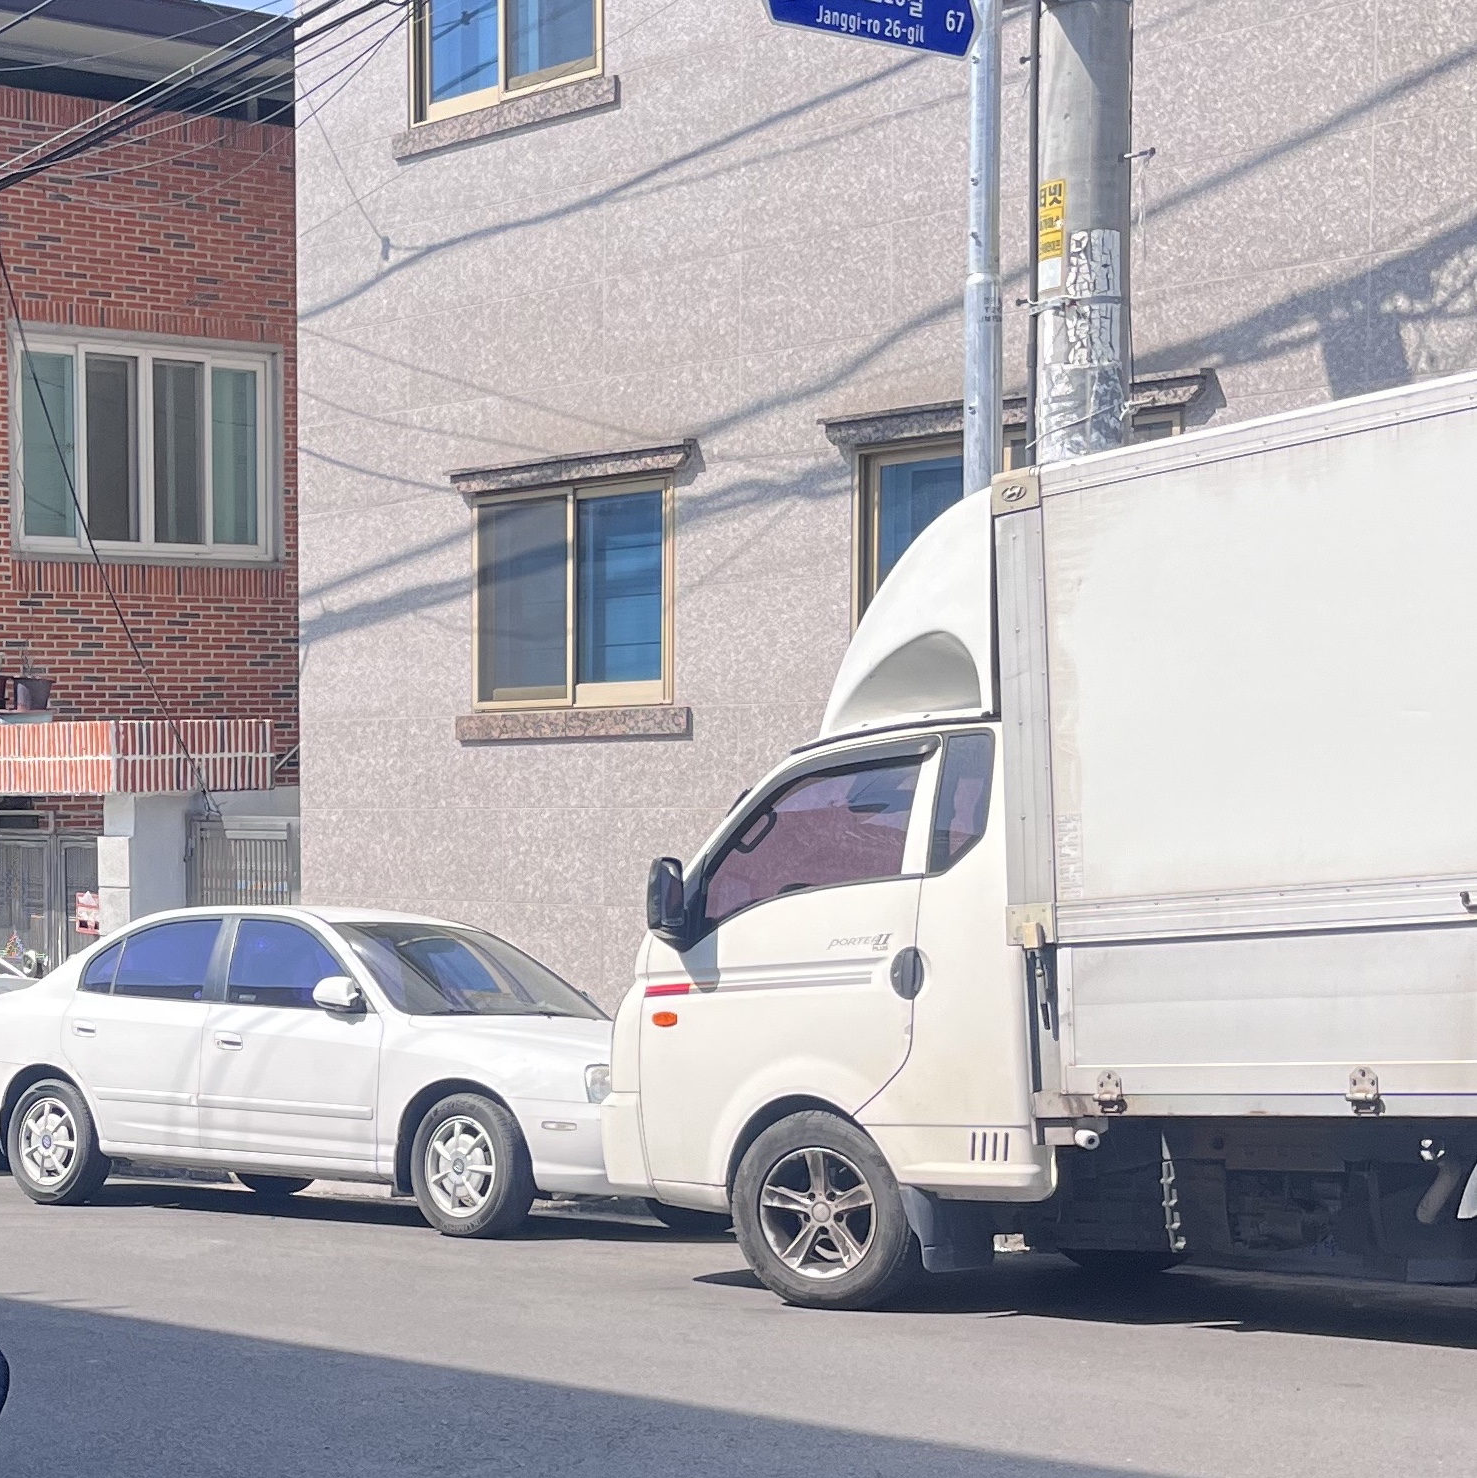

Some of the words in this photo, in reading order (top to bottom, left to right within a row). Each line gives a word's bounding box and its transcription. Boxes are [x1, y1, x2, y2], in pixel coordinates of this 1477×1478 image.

[816, 5, 881, 35] Janggi-ro
[884, 18, 925, 45] 26-gil
[945, 9, 966, 34] 67
[826, 935, 882, 950] PORTER
